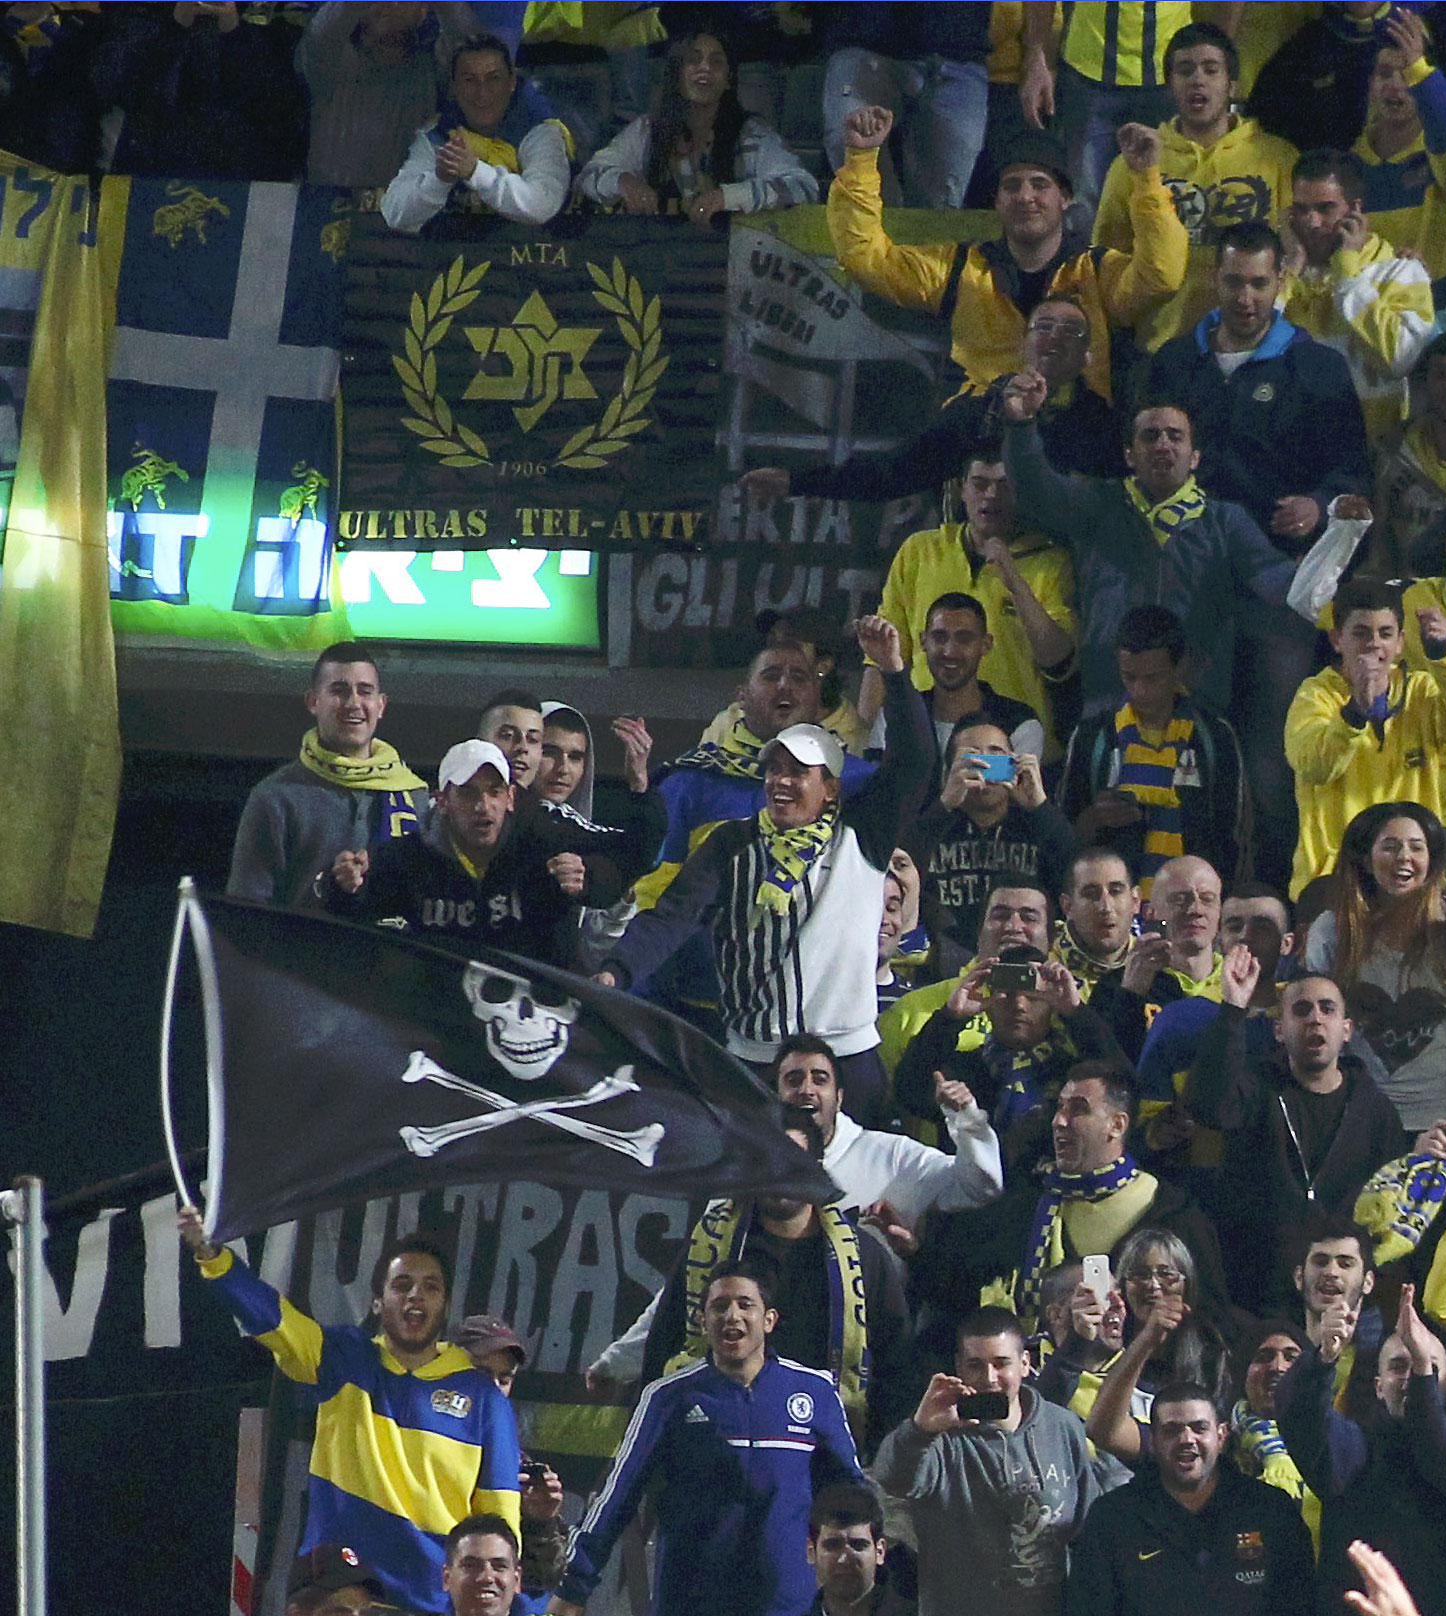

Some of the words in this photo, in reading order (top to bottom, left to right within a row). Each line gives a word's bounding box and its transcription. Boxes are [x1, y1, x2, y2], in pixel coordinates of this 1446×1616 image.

[511, 243, 568, 266] MTA
[748, 250, 852, 323] ULTRAS
[499, 461, 547, 476] 1906
[338, 509, 488, 540] ULTRAS
[515, 508, 704, 540] TEL-AVIV
